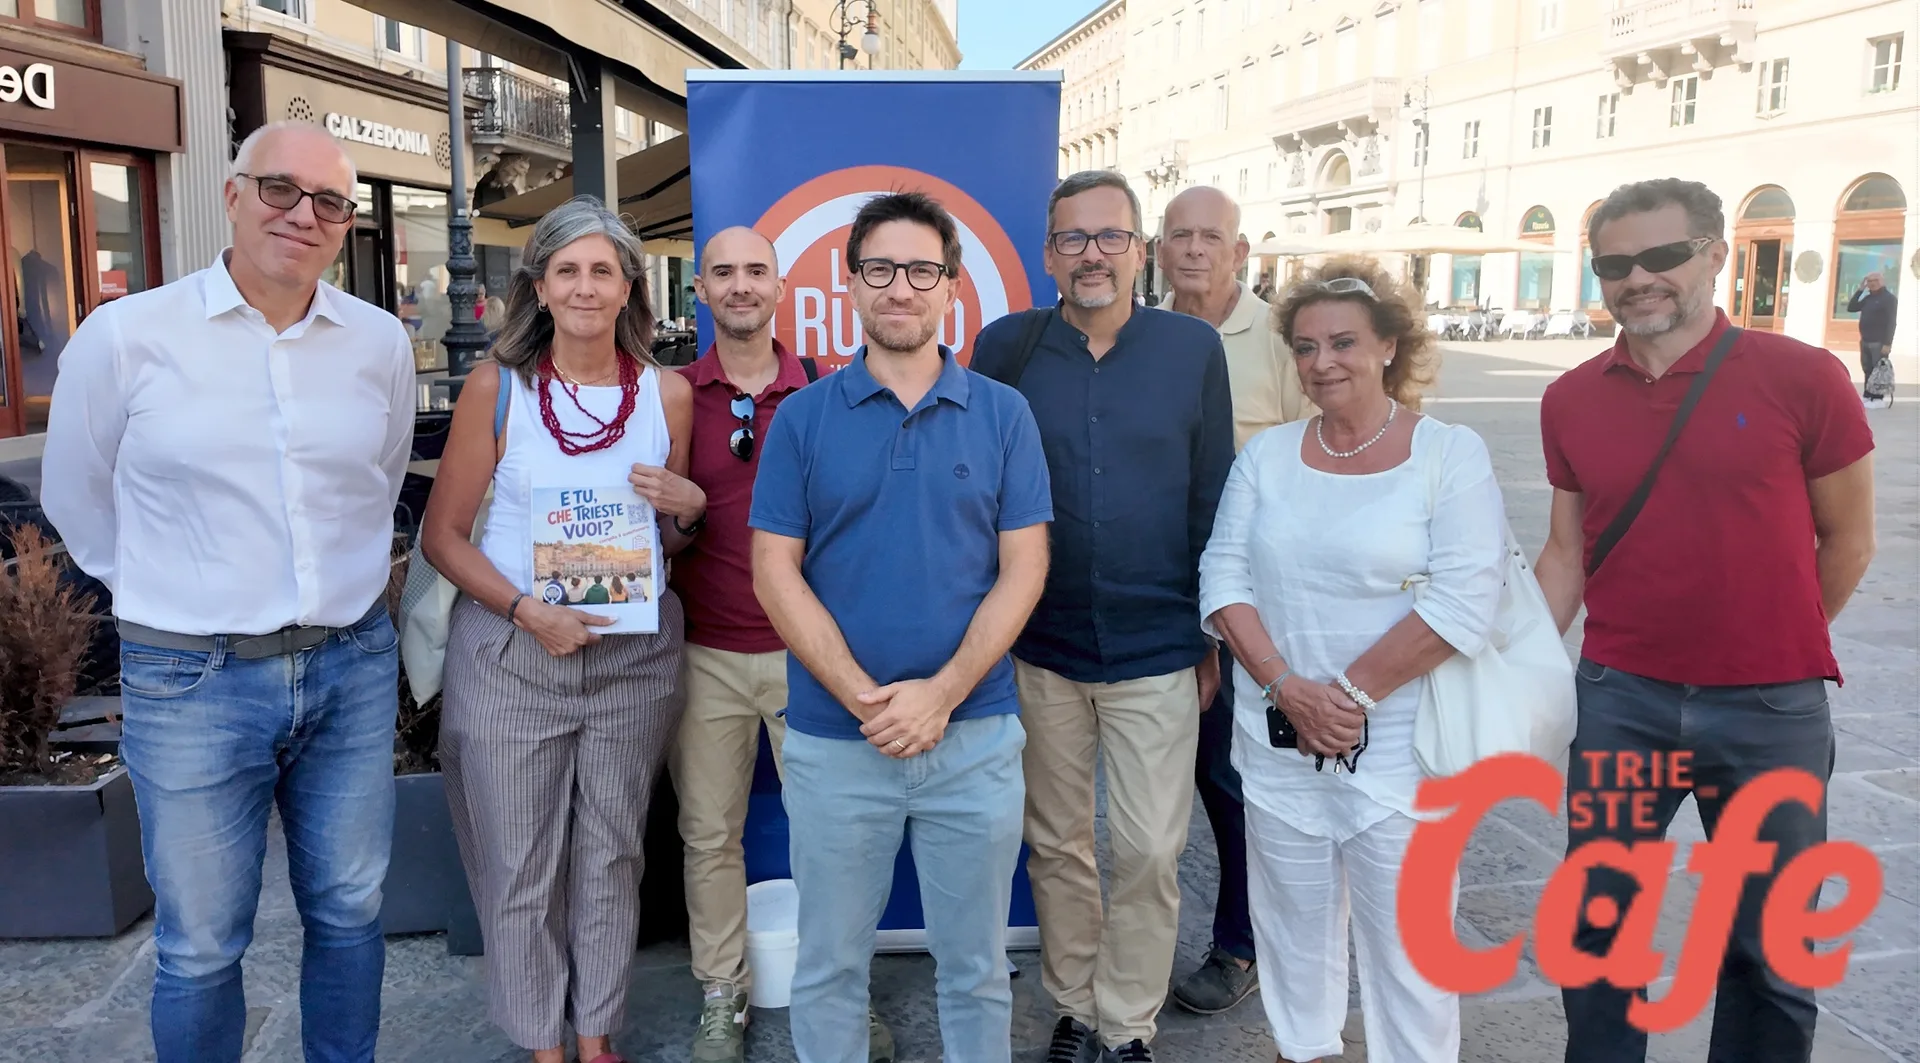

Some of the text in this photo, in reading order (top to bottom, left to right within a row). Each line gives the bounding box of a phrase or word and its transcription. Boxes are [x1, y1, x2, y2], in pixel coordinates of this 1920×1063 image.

[325, 112, 431, 156] CALZEDONIA
[560, 489, 598, 506] E TU,
[547, 503, 624, 525] CHE TRIESTE
[562, 520, 613, 540] VUOI?
